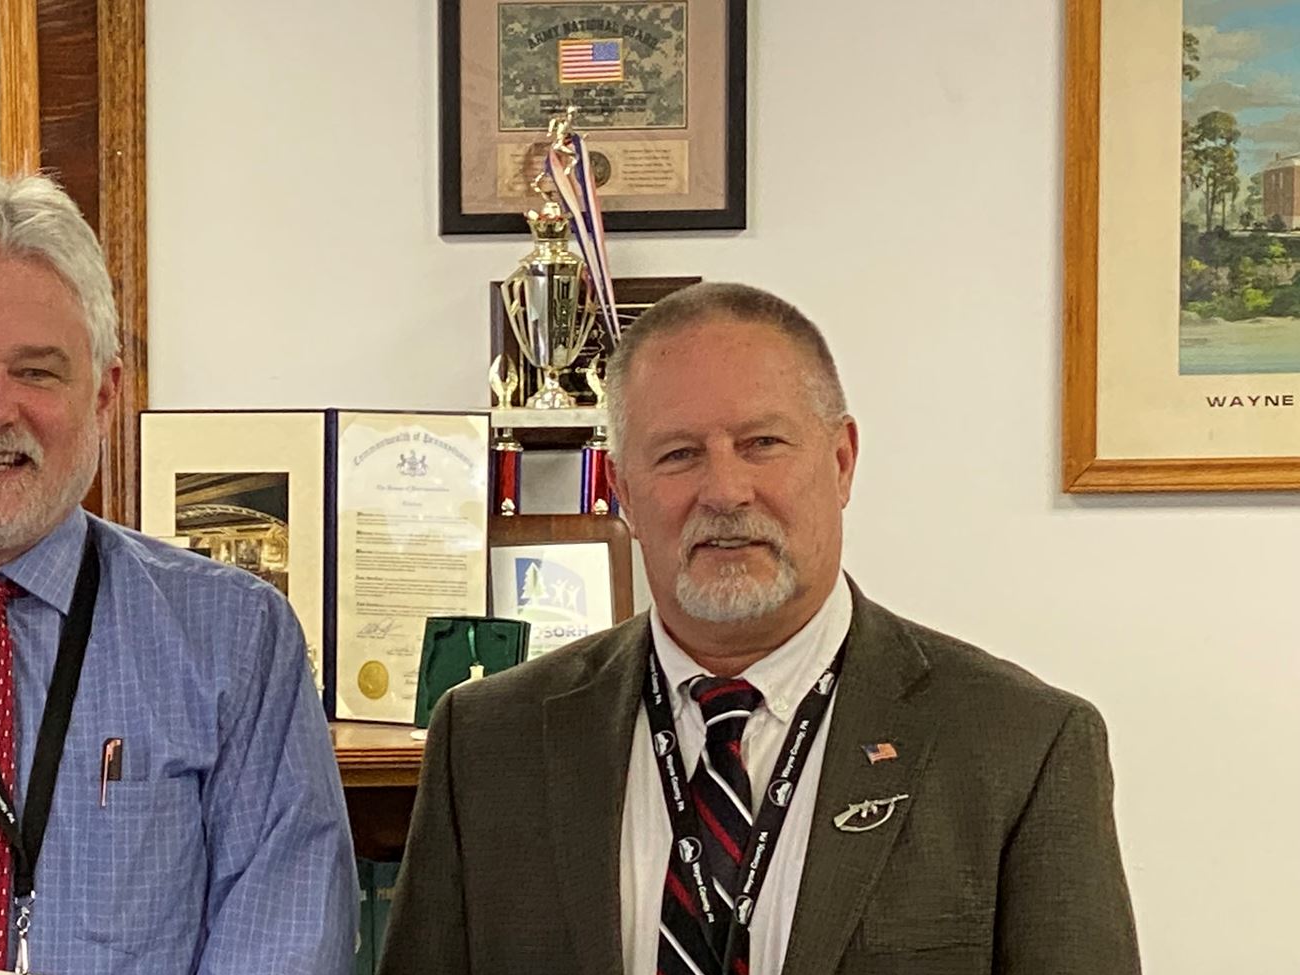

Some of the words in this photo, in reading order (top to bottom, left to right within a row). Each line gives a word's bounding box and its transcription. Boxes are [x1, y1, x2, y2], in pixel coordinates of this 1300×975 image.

[527, 24, 559, 50] ARMY
[1205, 394, 1294, 408] WAYNE
[781, 755, 796, 778] Wayne
[799, 719, 810, 731] PA
[759, 831, 769, 842] PA
